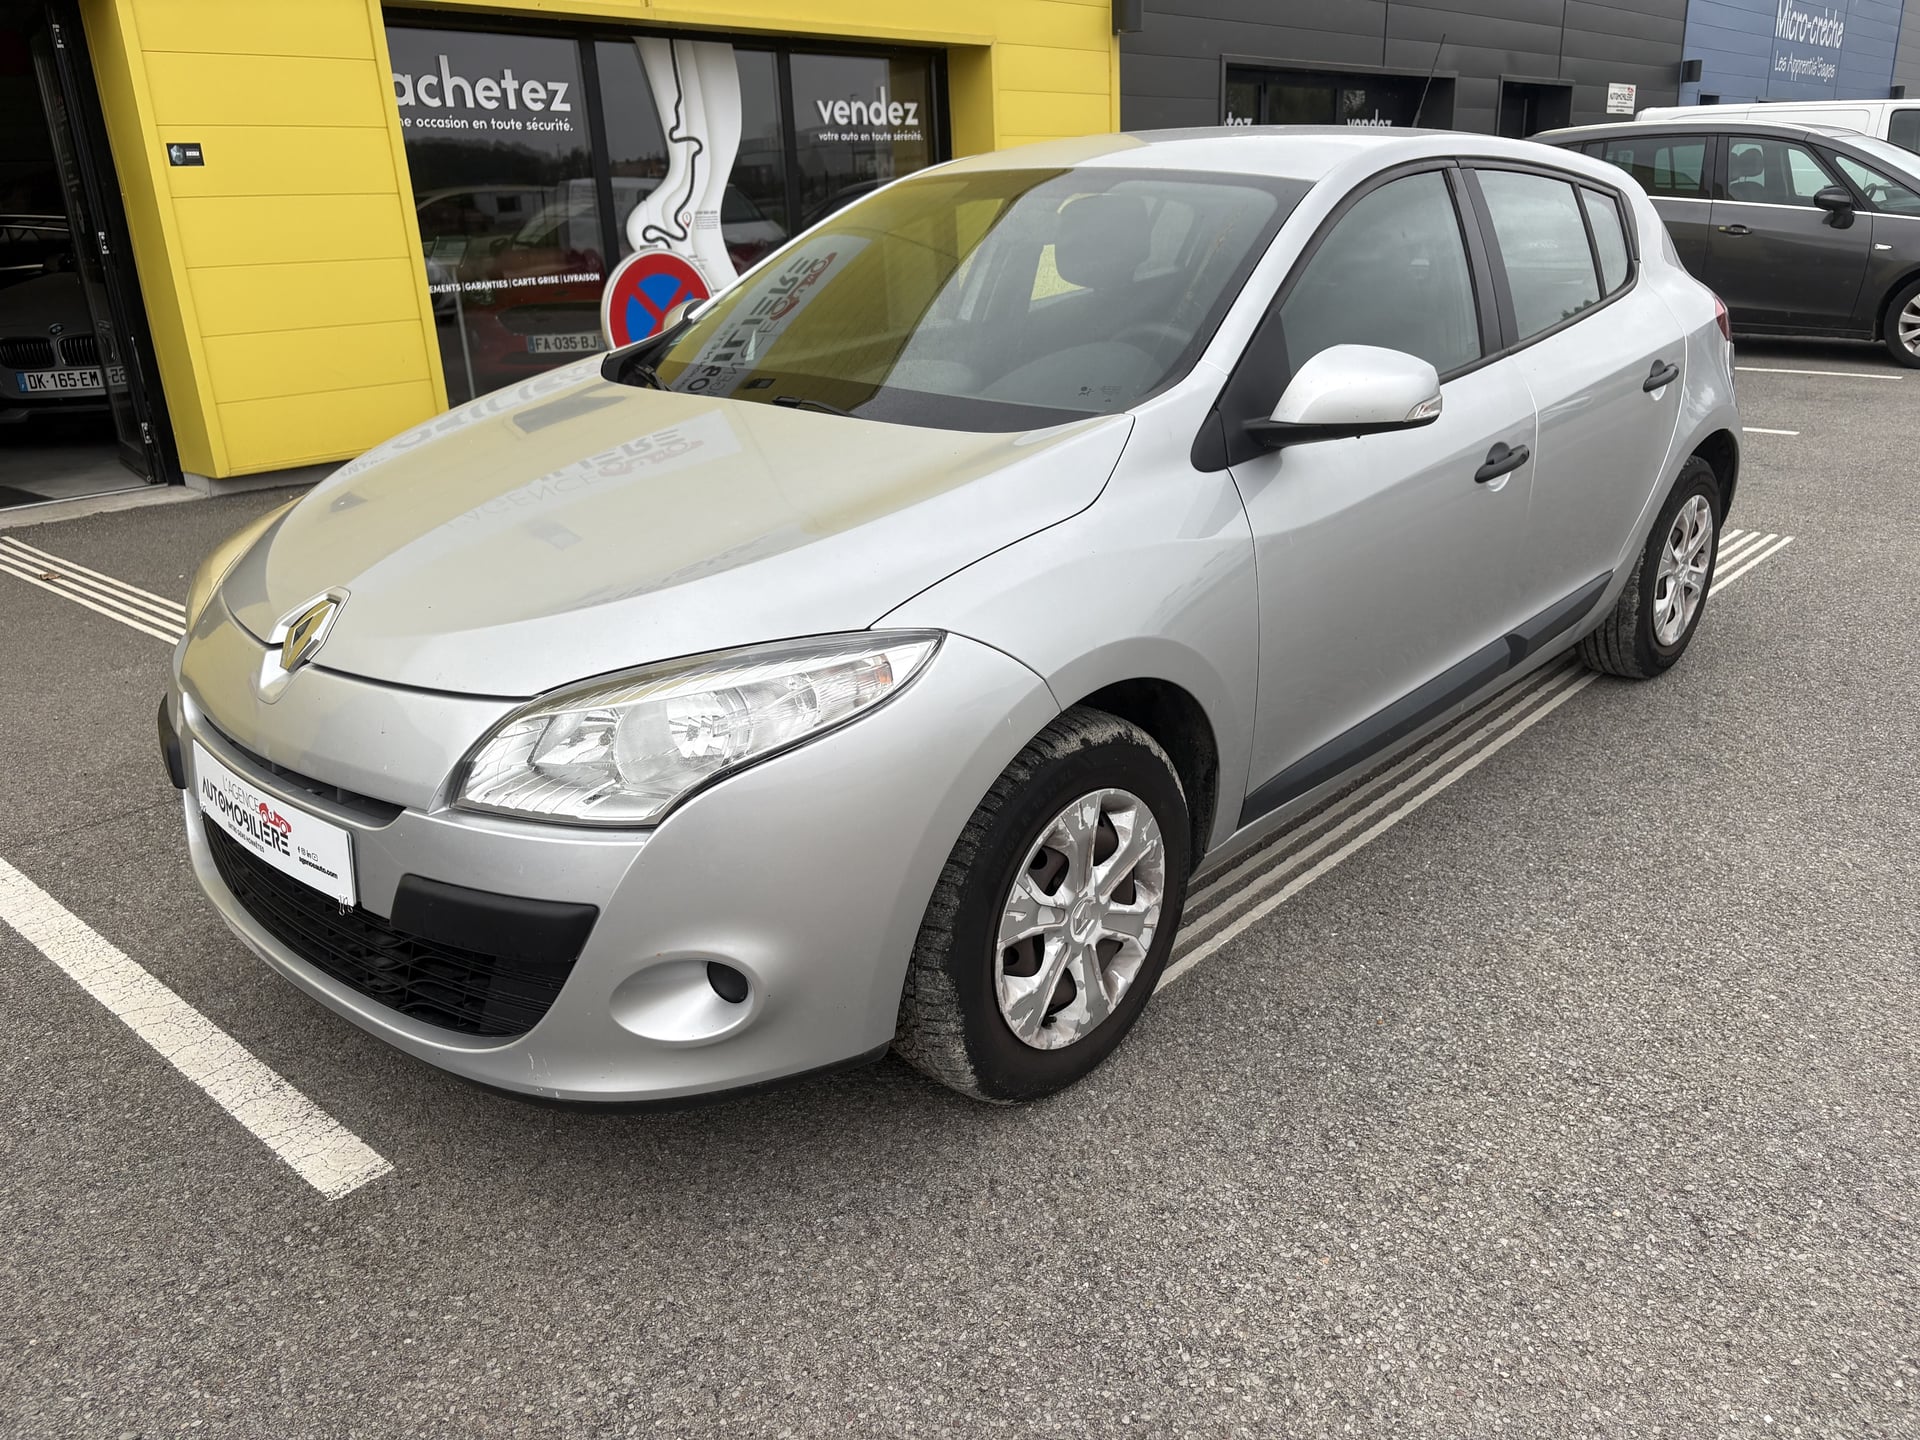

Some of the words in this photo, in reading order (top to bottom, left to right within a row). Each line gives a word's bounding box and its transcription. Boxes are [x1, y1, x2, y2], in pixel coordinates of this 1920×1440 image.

[1775, 0, 1844, 48] Micro-crèche
[1775, 50, 1787, 71] Les
[391, 55, 571, 111] achetez
[817, 86, 919, 125] vendez
[416, 115, 469, 128] occasion
[473, 119, 487, 129] en
[491, 118, 522, 130] toute
[526, 117, 573, 131] sécurité.
[819, 131, 839, 141] votre
[841, 131, 858, 141] auto
[861, 133, 870, 141] en
[872, 131, 891, 141] toute
[894, 130, 923, 141] sérénité.
[465, 279, 508, 291] GARANTIES
[512, 277, 537, 287] CARTE
[538, 275, 559, 285] GRISE
[563, 272, 600, 283] LIVRAISON
[222, 775, 261, 816] L'AGENCE
